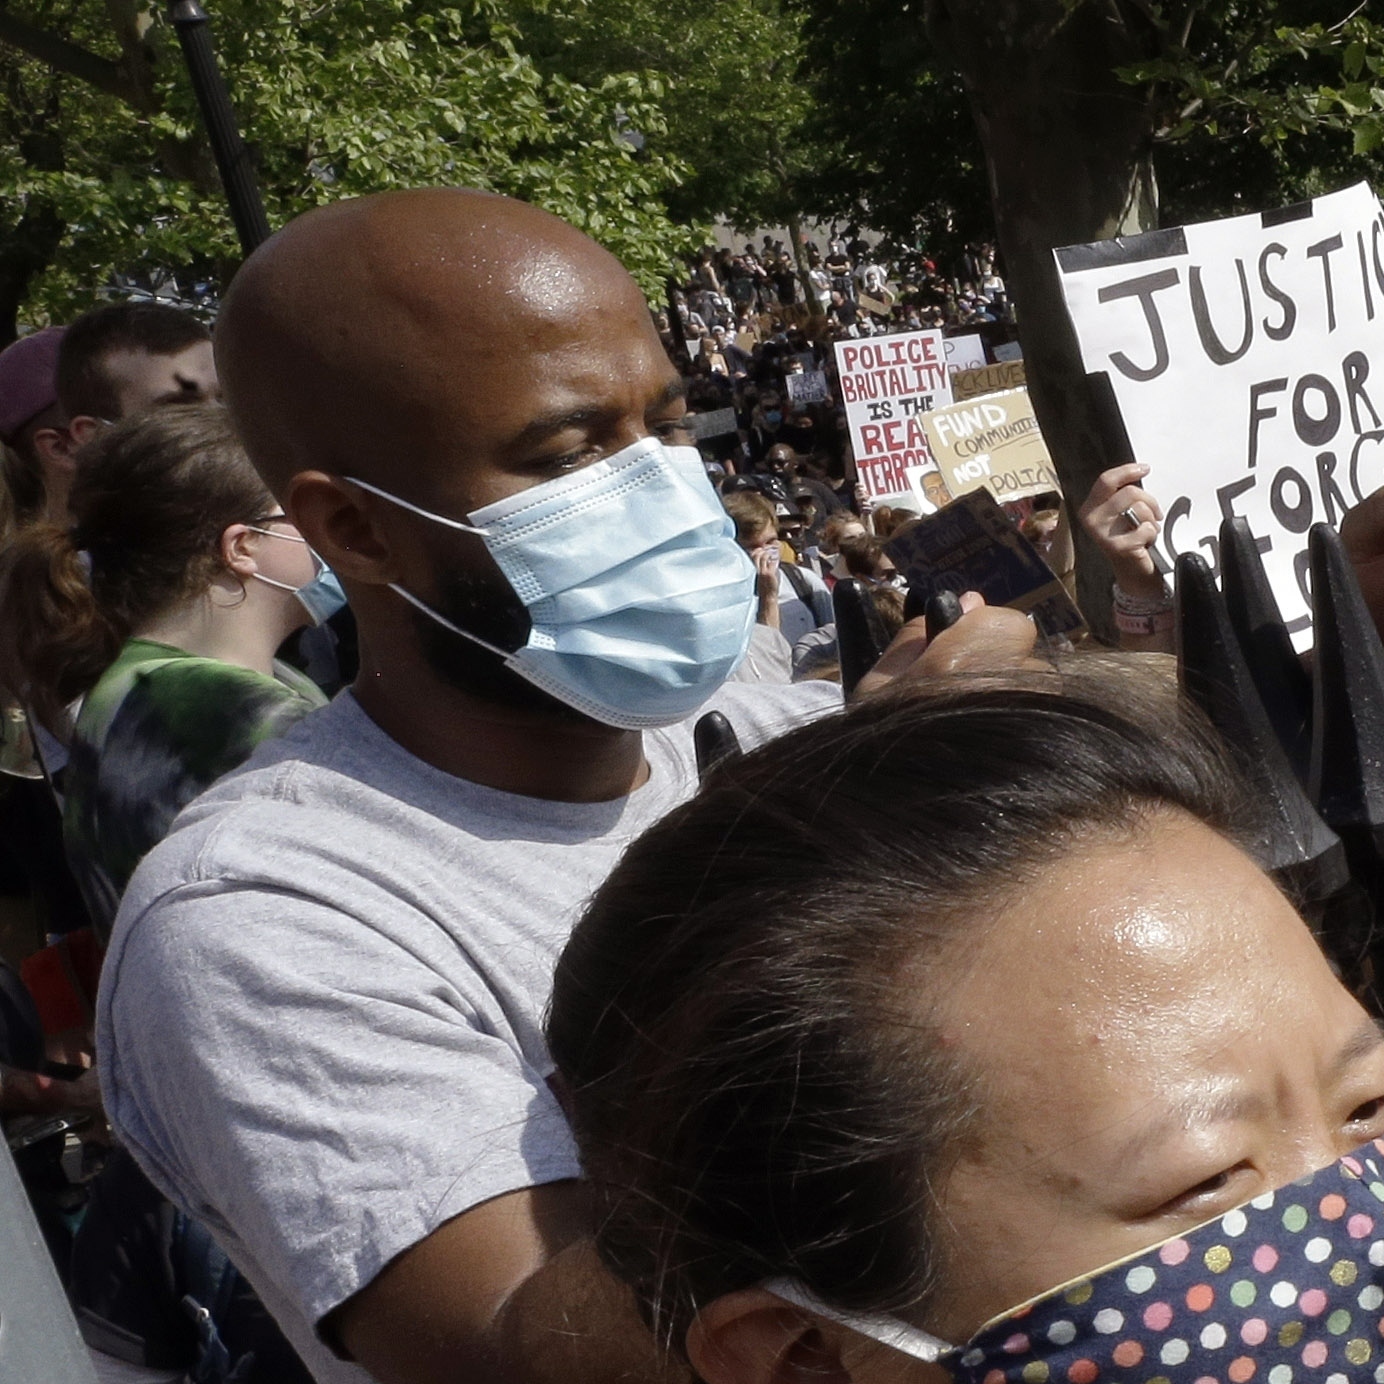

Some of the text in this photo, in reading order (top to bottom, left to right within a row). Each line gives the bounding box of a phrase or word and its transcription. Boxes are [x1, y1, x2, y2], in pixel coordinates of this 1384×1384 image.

[843, 337, 937, 373] POLICE
[842, 362, 949, 403] BRUTALITY
[867, 396, 934, 421] IS THE
[932, 403, 1008, 447] FUND
[1248, 350, 1382, 469] FOR
[860, 418, 930, 456] REA
[952, 453, 992, 485] NOT
